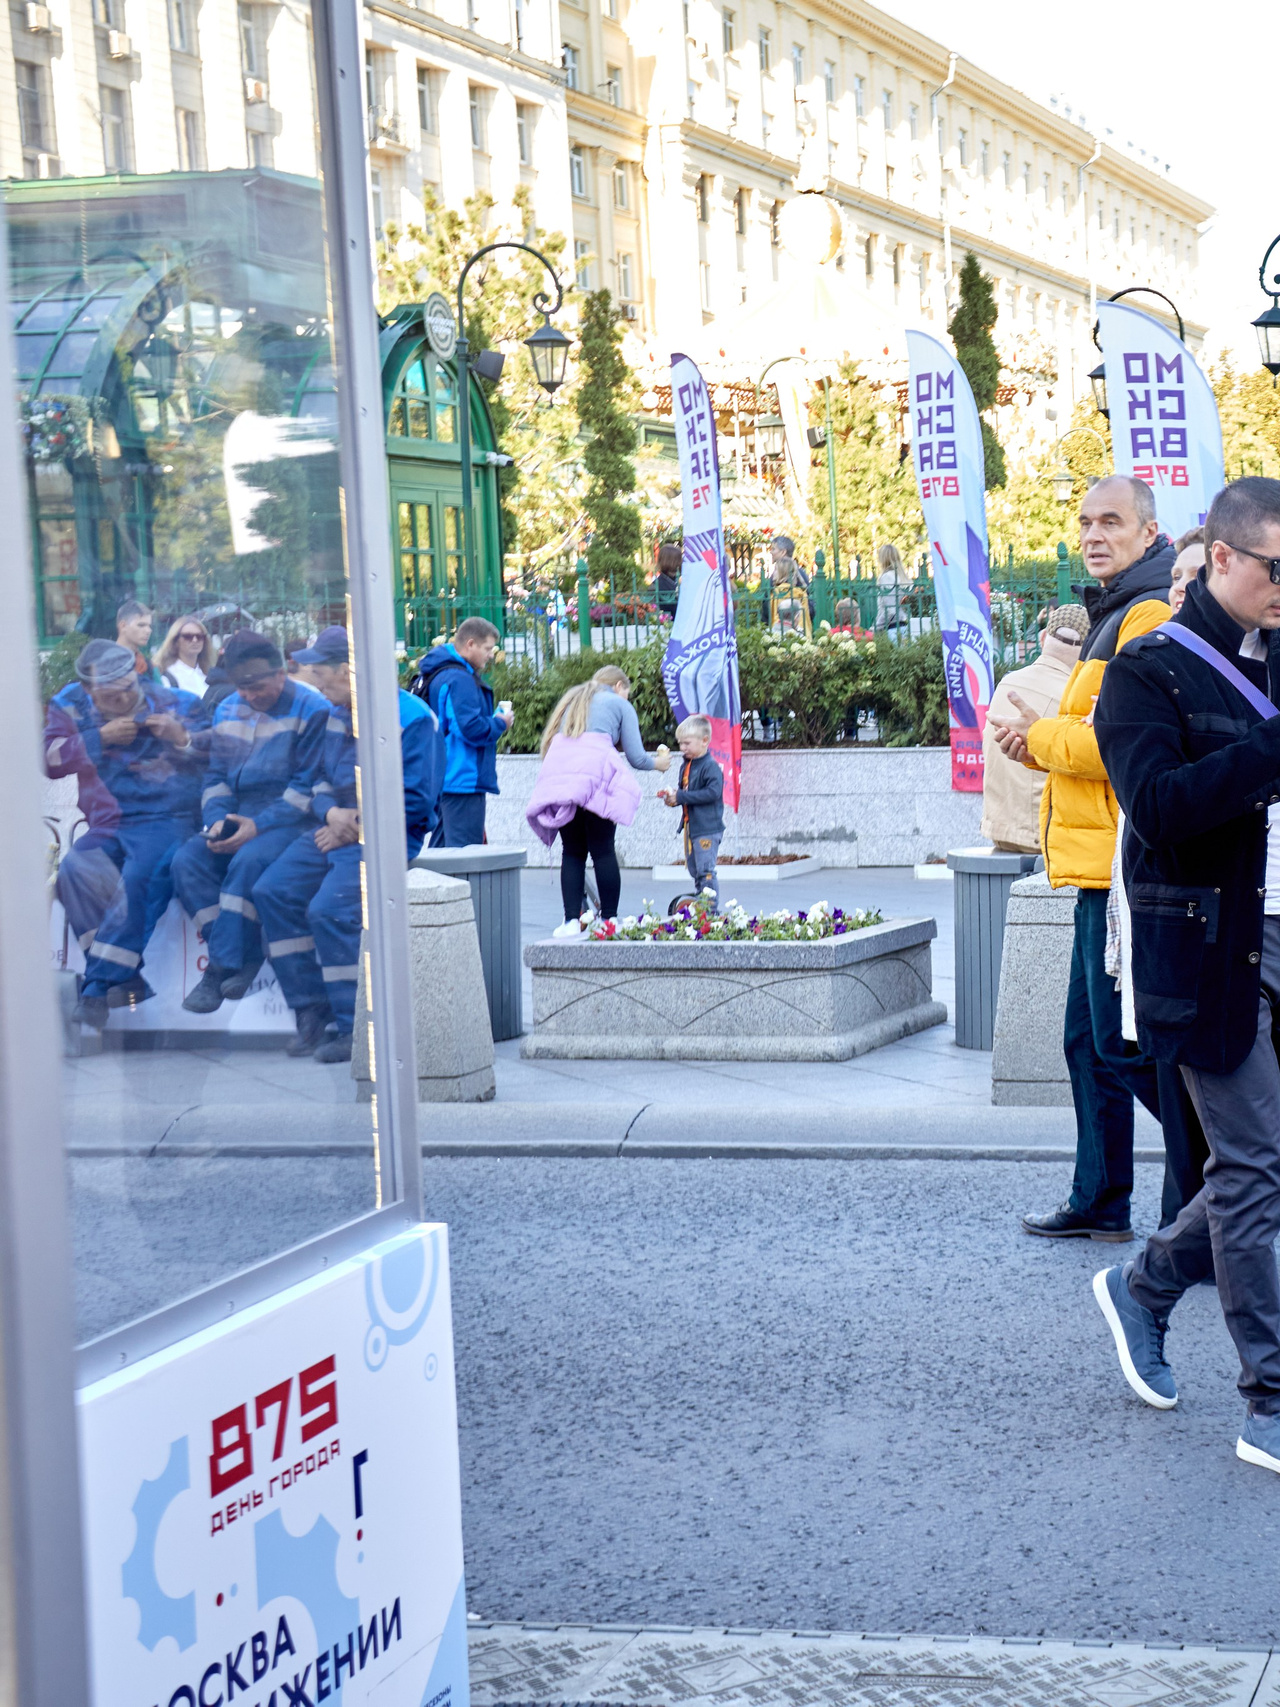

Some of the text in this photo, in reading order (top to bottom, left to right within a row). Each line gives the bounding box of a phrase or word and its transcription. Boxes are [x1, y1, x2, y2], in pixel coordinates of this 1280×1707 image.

[208, 1353, 339, 1499] 875
[211, 1438, 341, 1537] ДЕНЬ ГОРОДА
[152, 1614, 297, 1707] ОСКВА
